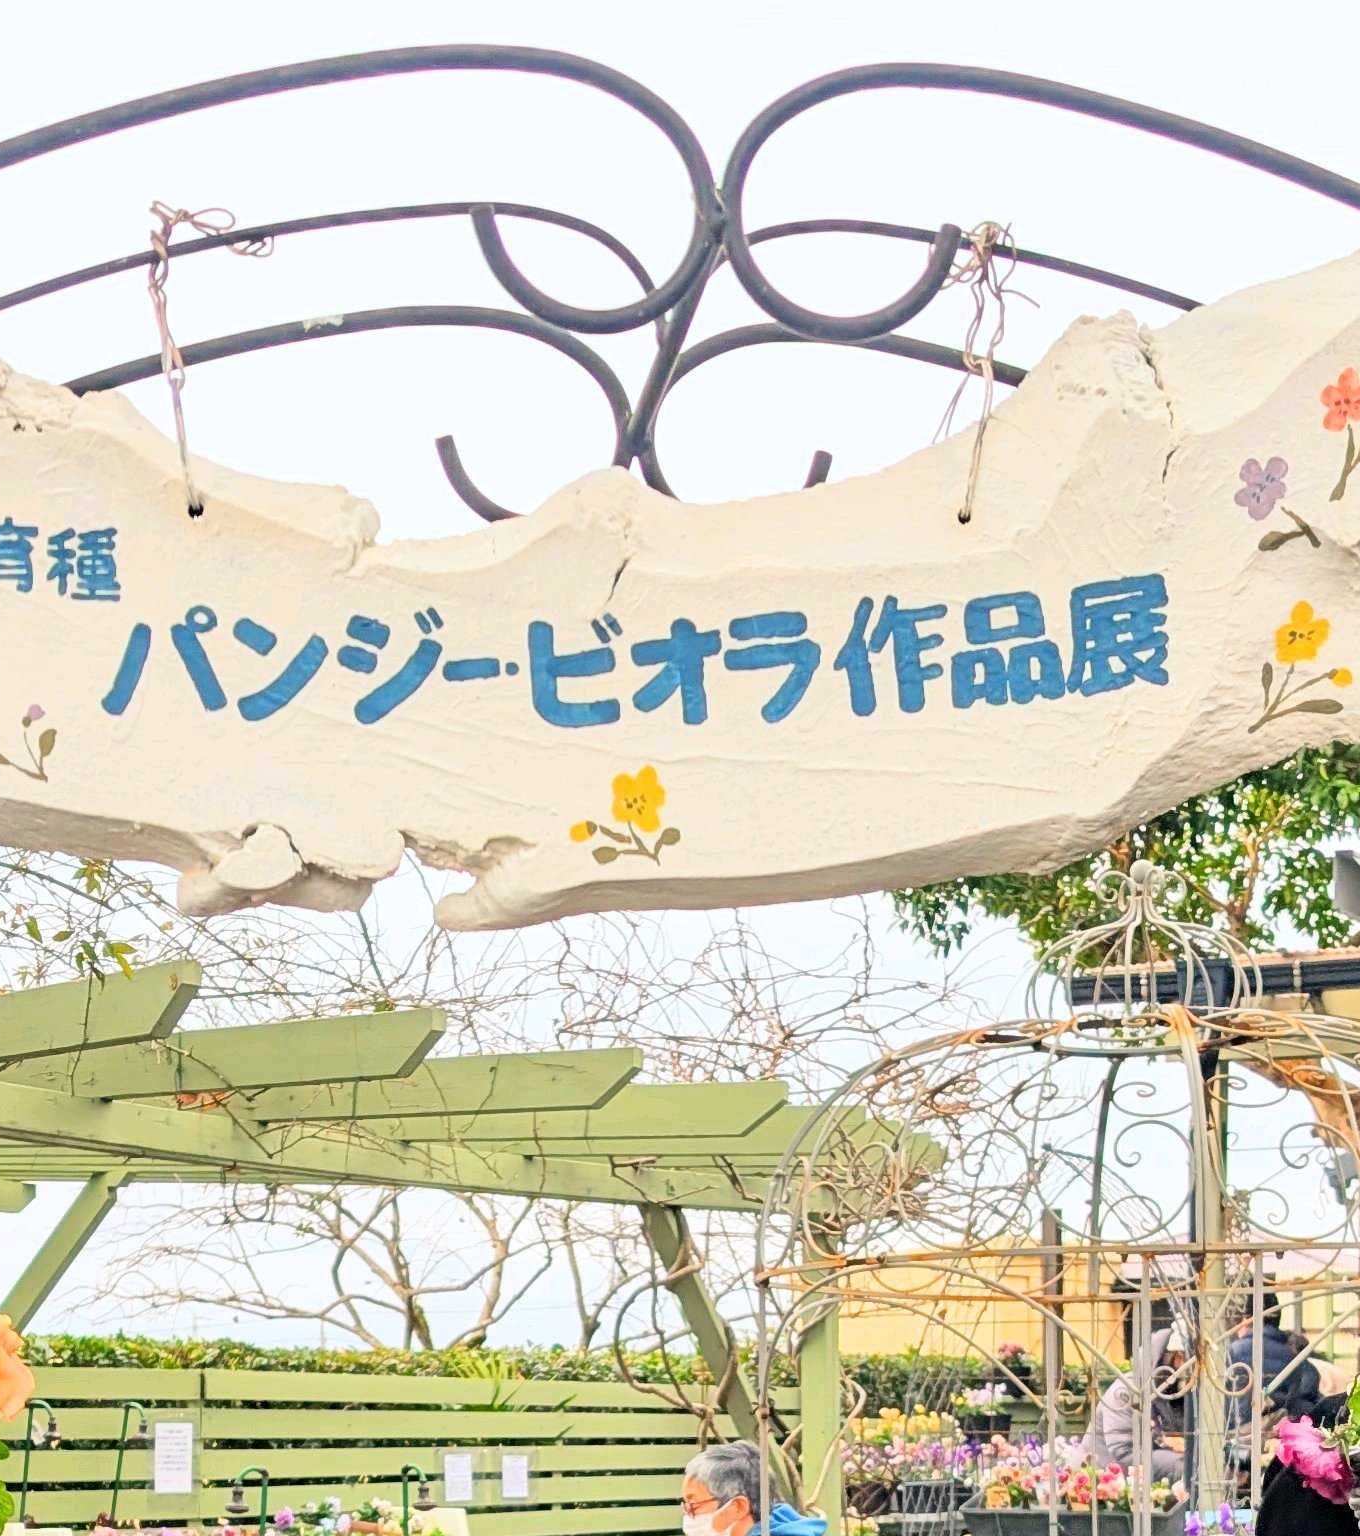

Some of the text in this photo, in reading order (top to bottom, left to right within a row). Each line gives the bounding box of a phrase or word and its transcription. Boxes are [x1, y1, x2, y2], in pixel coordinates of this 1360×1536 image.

[103, 574, 1169, 724] パンジー・ビオラ作品展
